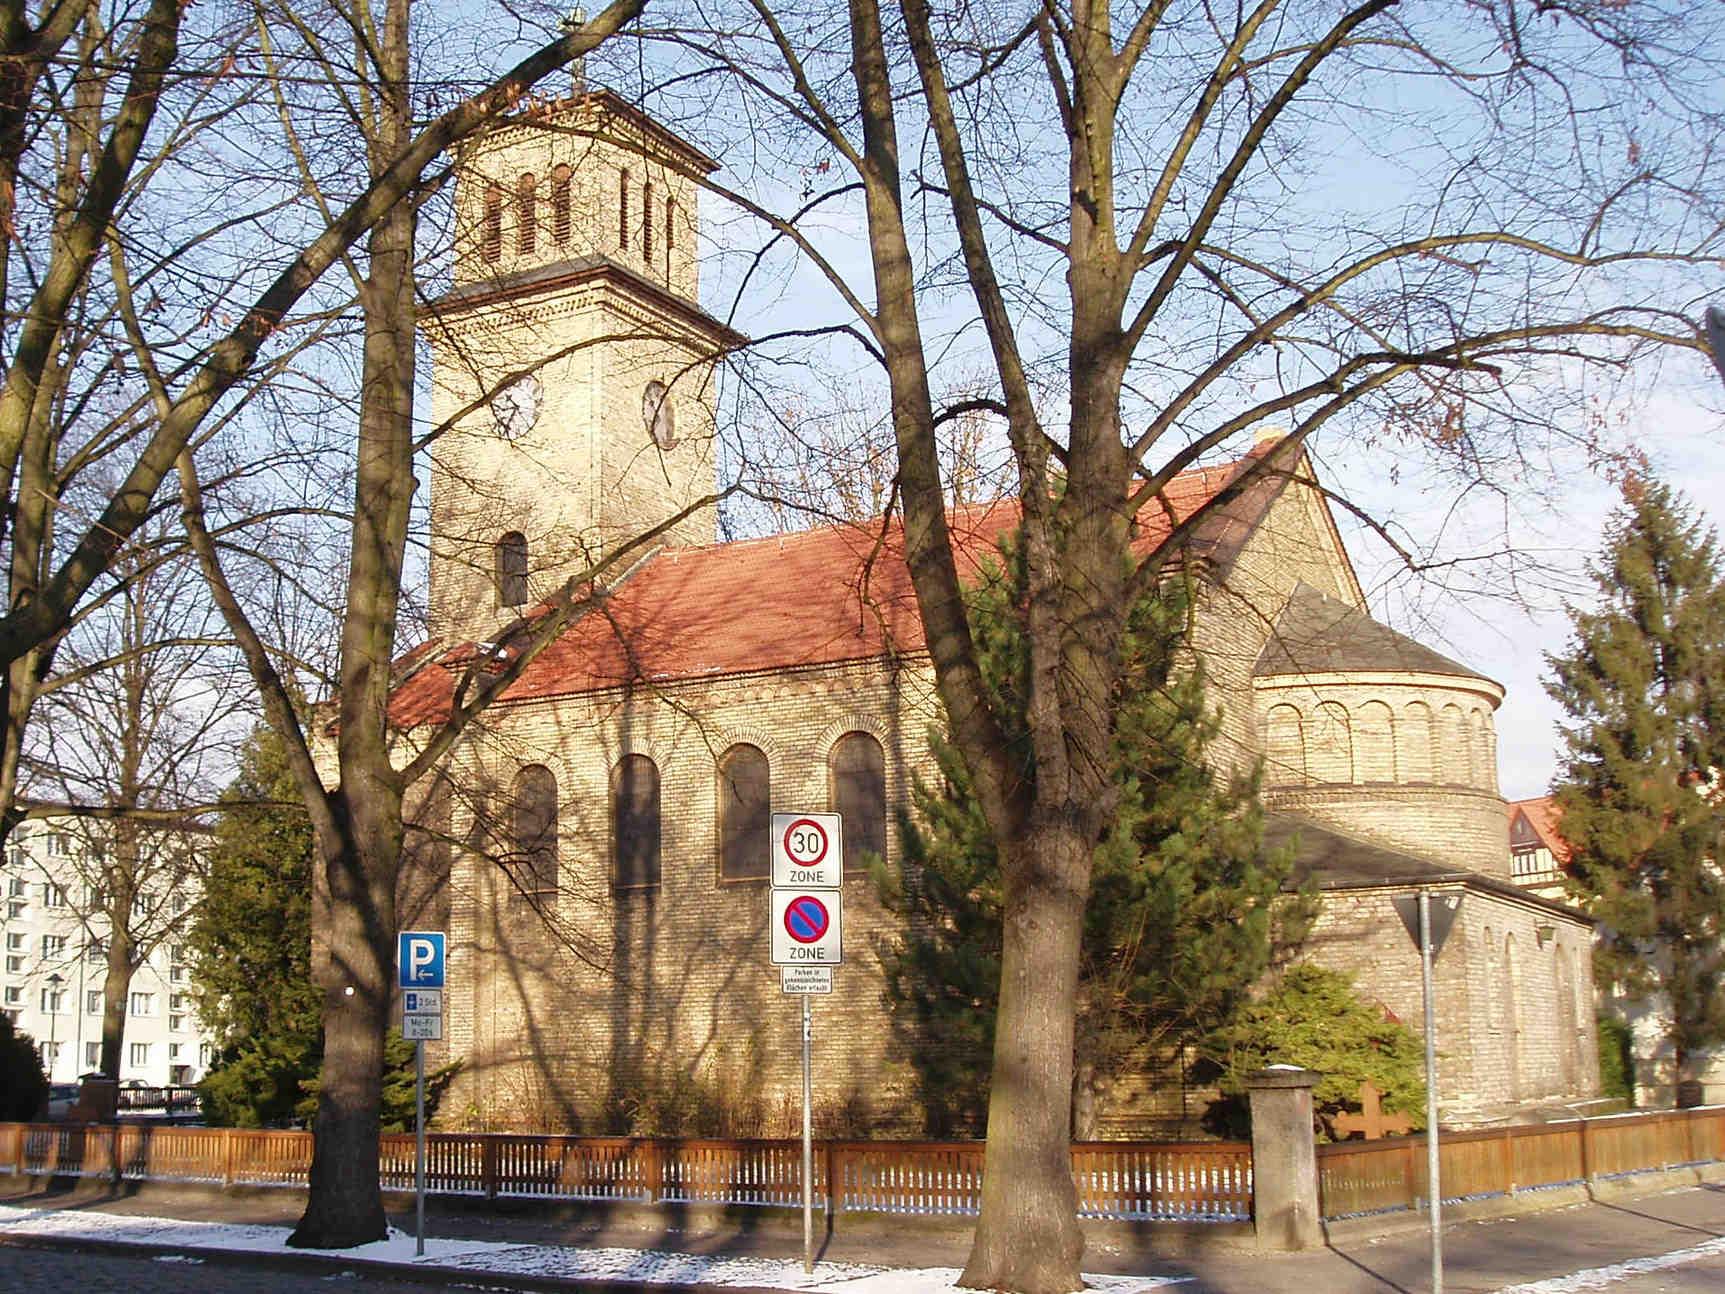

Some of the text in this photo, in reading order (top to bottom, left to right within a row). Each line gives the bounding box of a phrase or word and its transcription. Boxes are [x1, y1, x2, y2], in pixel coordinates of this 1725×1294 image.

[793, 832, 819, 854] 30
[790, 870, 825, 883] ZONE
[410, 939, 435, 981] P
[789, 947, 825, 960] ZONE
